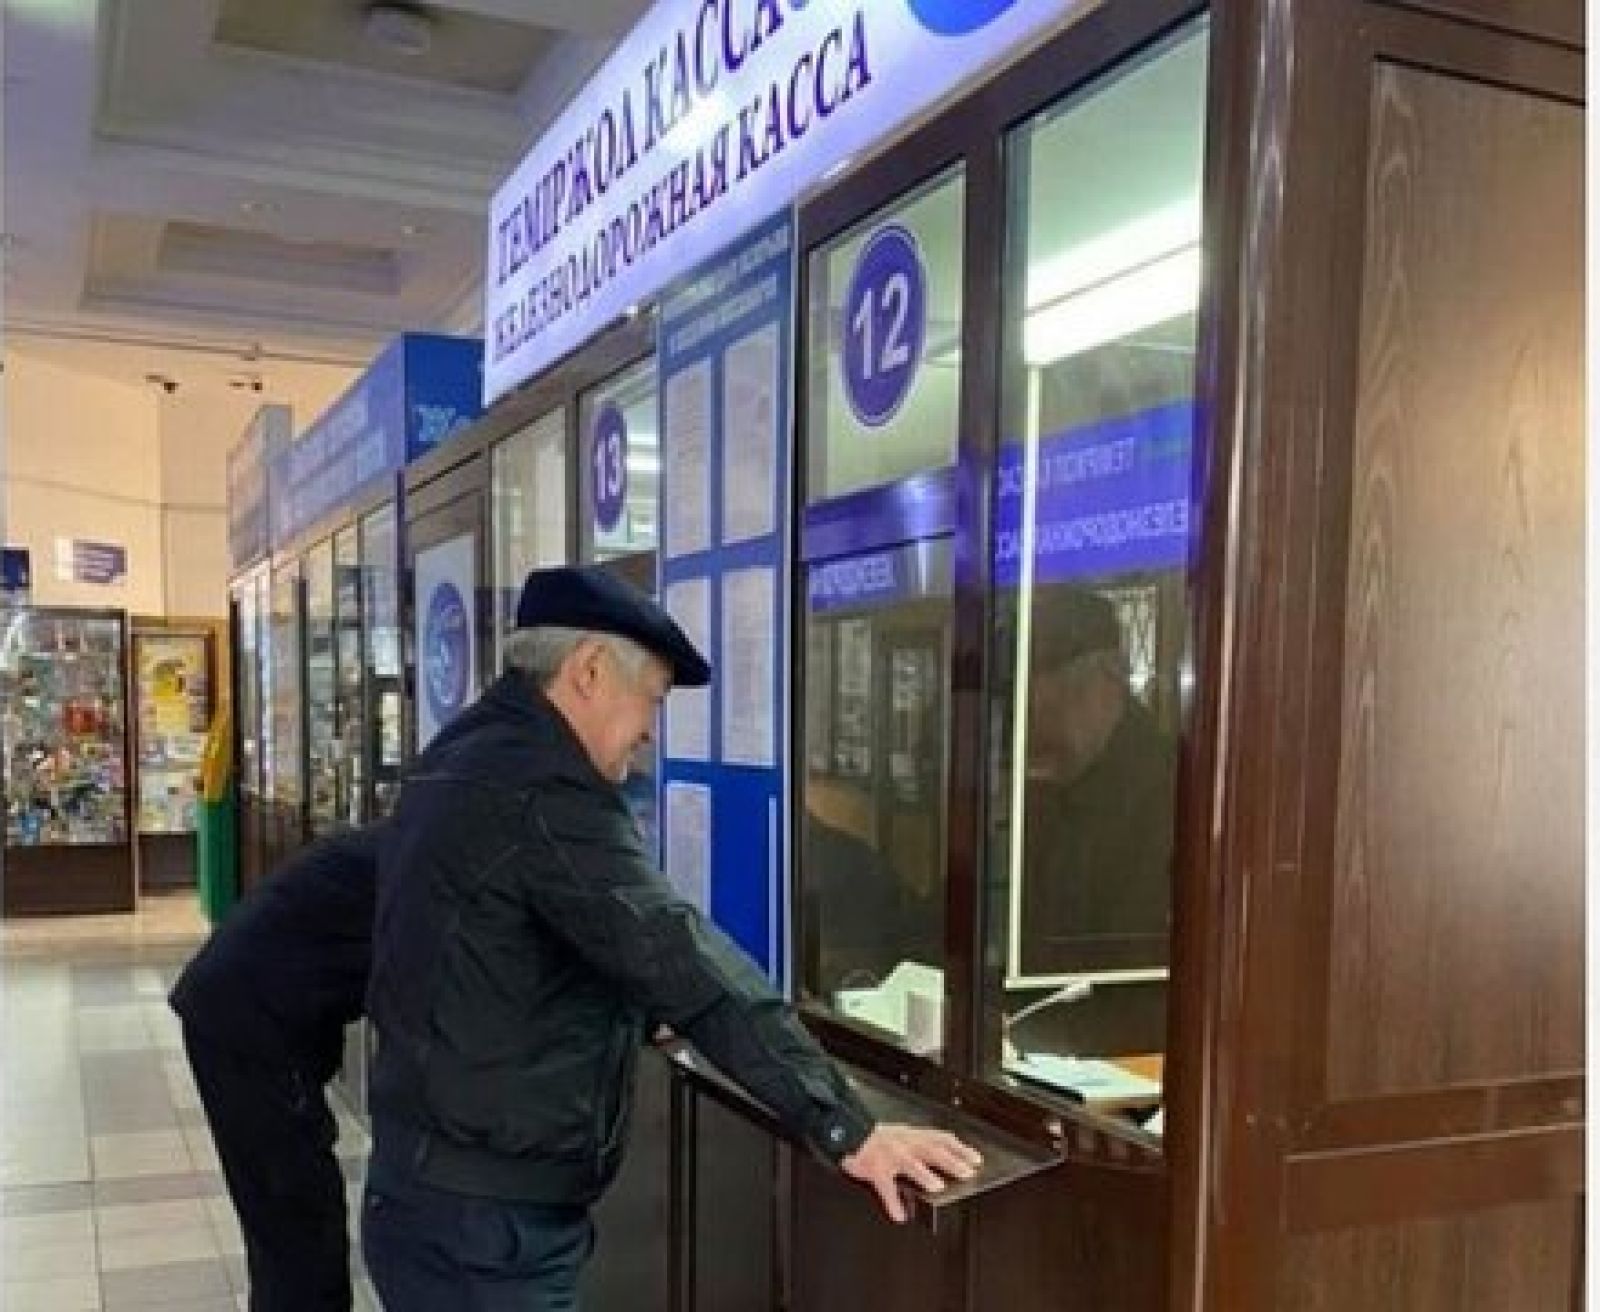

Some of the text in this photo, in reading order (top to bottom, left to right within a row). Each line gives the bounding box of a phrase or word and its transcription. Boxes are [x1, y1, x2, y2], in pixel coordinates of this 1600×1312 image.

[643, 0, 808, 151] КАССА
[494, 122, 730, 363] ЖЕЛЕЗНОДОРОЖНАЯ
[736, 10, 872, 182] КАССА
[853, 272, 910, 380] 12
[596, 431, 623, 502] 13
